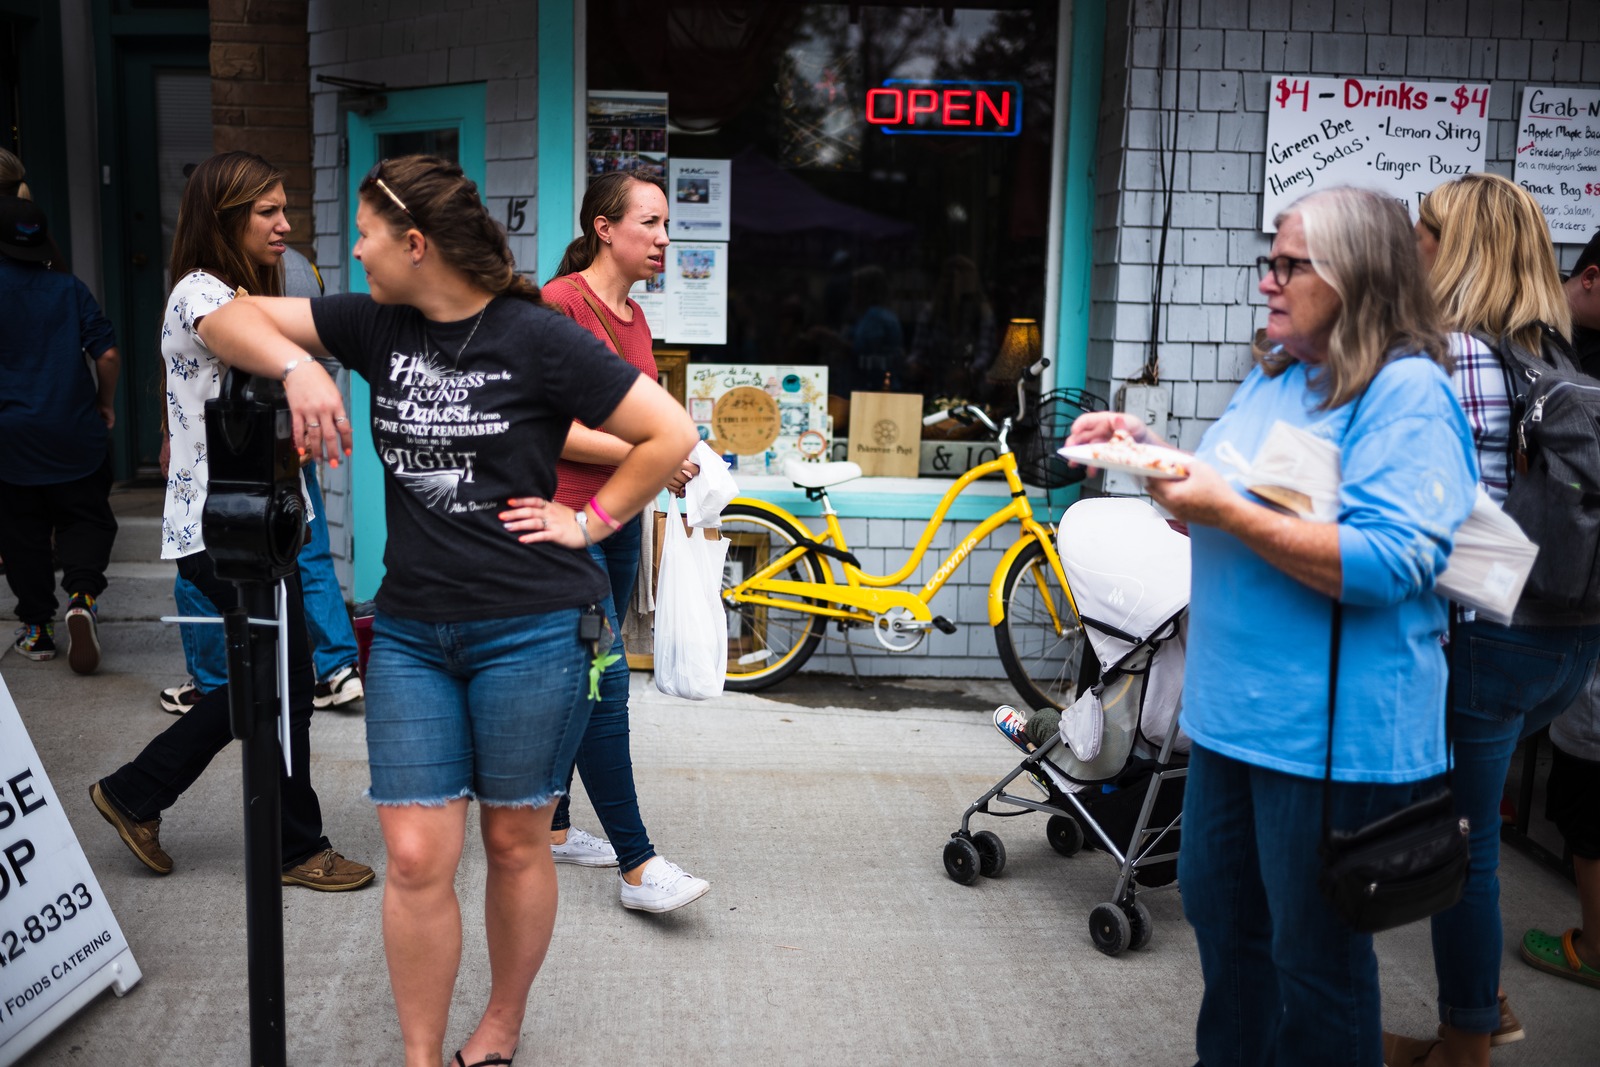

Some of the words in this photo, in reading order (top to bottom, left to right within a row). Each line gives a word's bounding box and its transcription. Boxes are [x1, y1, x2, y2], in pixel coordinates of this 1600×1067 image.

[865, 88, 1010, 126] OPEN
[1275, 78, 1310, 112] $4
[1343, 79, 1429, 110] Drinks
[1450, 84, 1490, 118] $4
[1271, 131, 1320, 165] Green
[1319, 118, 1355, 141] Bee
[1385, 116, 1431, 139] Lemon
[1435, 120, 1481, 152] Sting
[1527, 123, 1553, 142] Apple
[1555, 125, 1582, 142] Maple
[1375, 152, 1421, 180] Ginger
[1428, 154, 1472, 175] Buzz
[1564, 147, 1582, 160] Apple
[1267, 167, 1315, 197] Honey
[1313, 137, 1365, 171] Sodas
[1517, 161, 1528, 170] on
[1537, 162, 1575, 175] multigrain
[1520, 180, 1555, 196] Snack
[1560, 181, 1582, 202] Bag
[507, 197, 529, 232] 15
[1551, 218, 1586, 232] Crackers
[407, 387, 469, 402] FOUND
[397, 401, 472, 424] Darkest
[380, 419, 399, 434] ONE
[399, 422, 432, 437] ONLY
[431, 421, 510, 437] REMEMBERS
[384, 447, 477, 483] LIGHT
[932, 445, 952, 471] &
